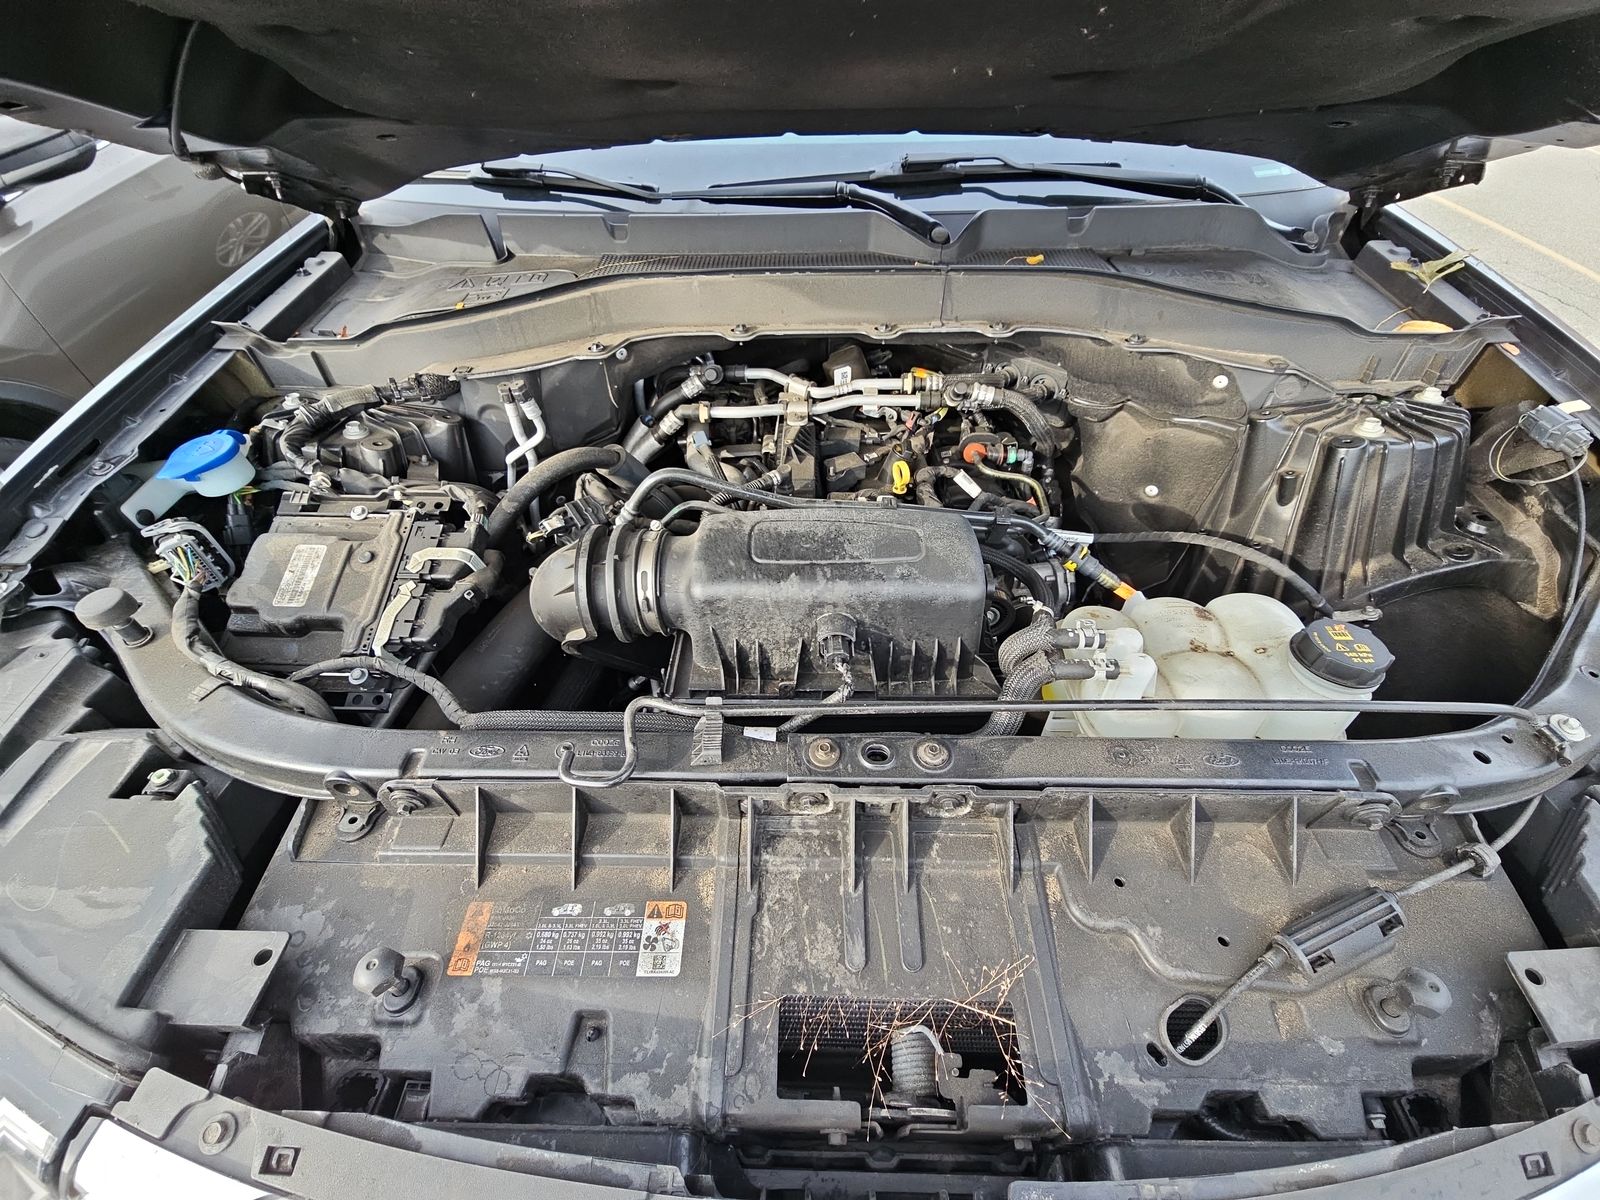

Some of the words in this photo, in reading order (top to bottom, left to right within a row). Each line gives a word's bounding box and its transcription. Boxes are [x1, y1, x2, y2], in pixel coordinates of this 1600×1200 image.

[471, 745, 504, 758] Ford
[552, 931, 559, 940] kg
[578, 931, 586, 940] kg
[607, 931, 615, 940] kg
[633, 931, 641, 940] kg
[475, 959, 490, 967] PAG
[473, 966, 489, 974] POE
